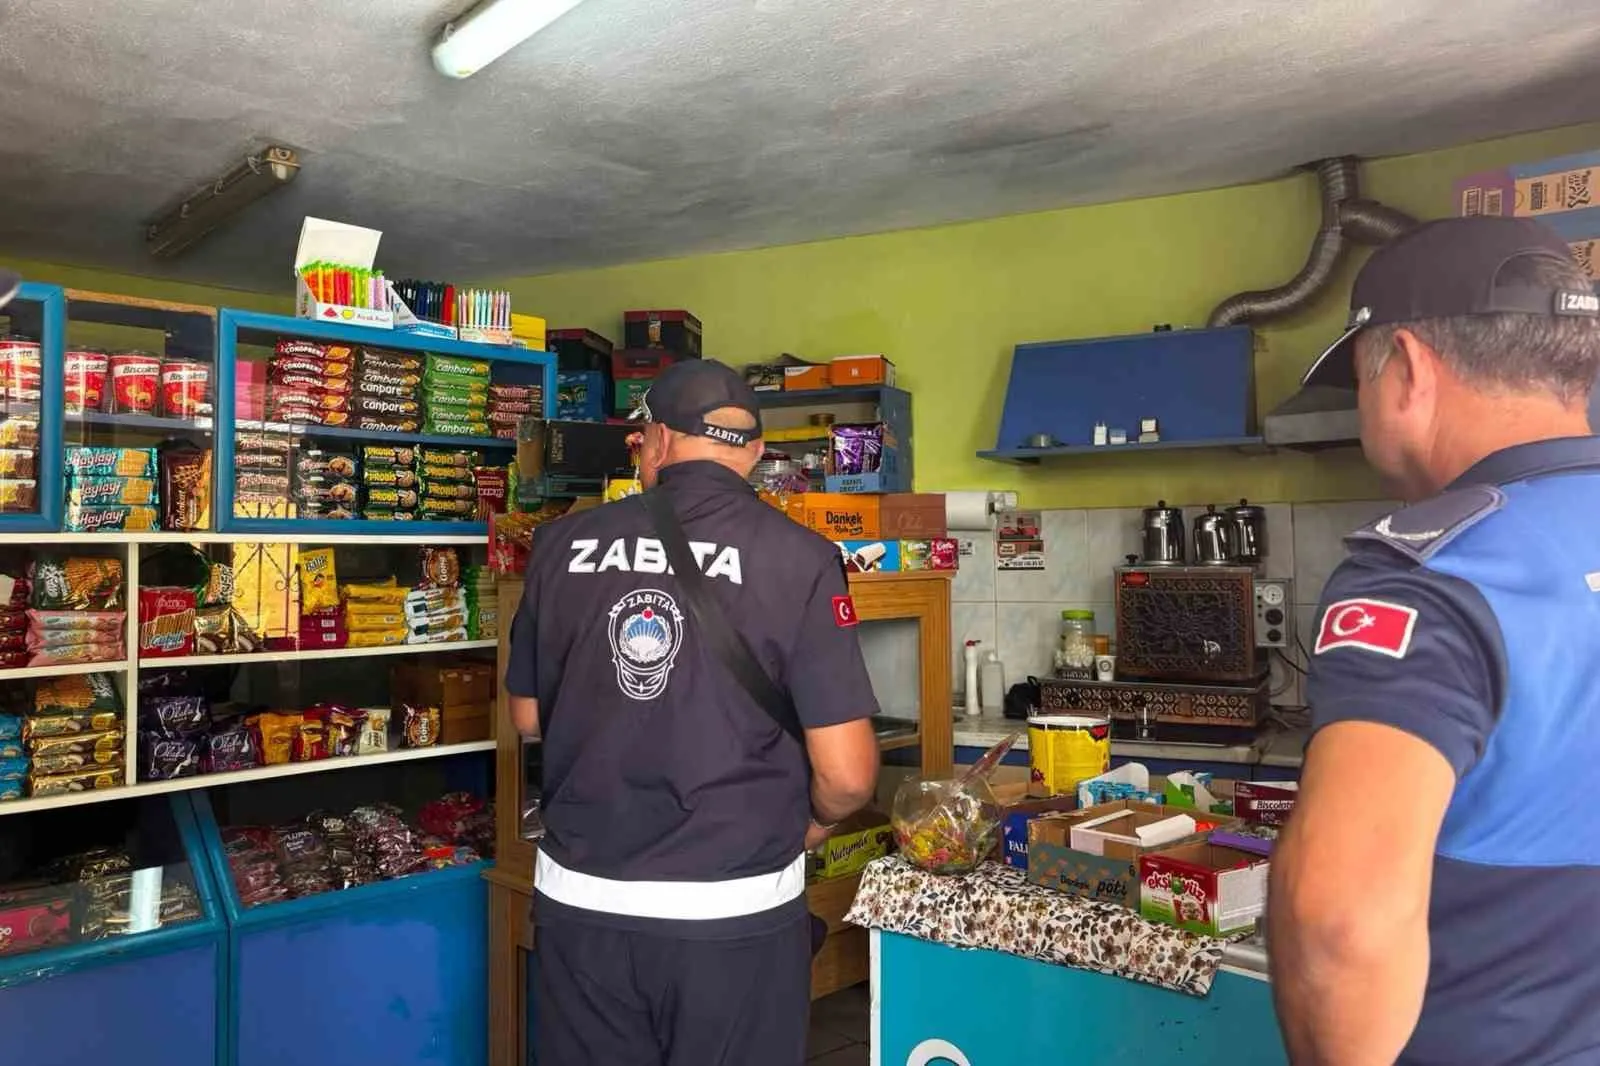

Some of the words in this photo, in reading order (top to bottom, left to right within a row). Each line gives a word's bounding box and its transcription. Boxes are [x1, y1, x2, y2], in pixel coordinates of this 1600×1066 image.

[705, 426, 744, 445] ZABITA
[826, 511, 863, 525] Dankek
[568, 537, 742, 584] ZABTA
[626, 594, 673, 611] ZABITA
